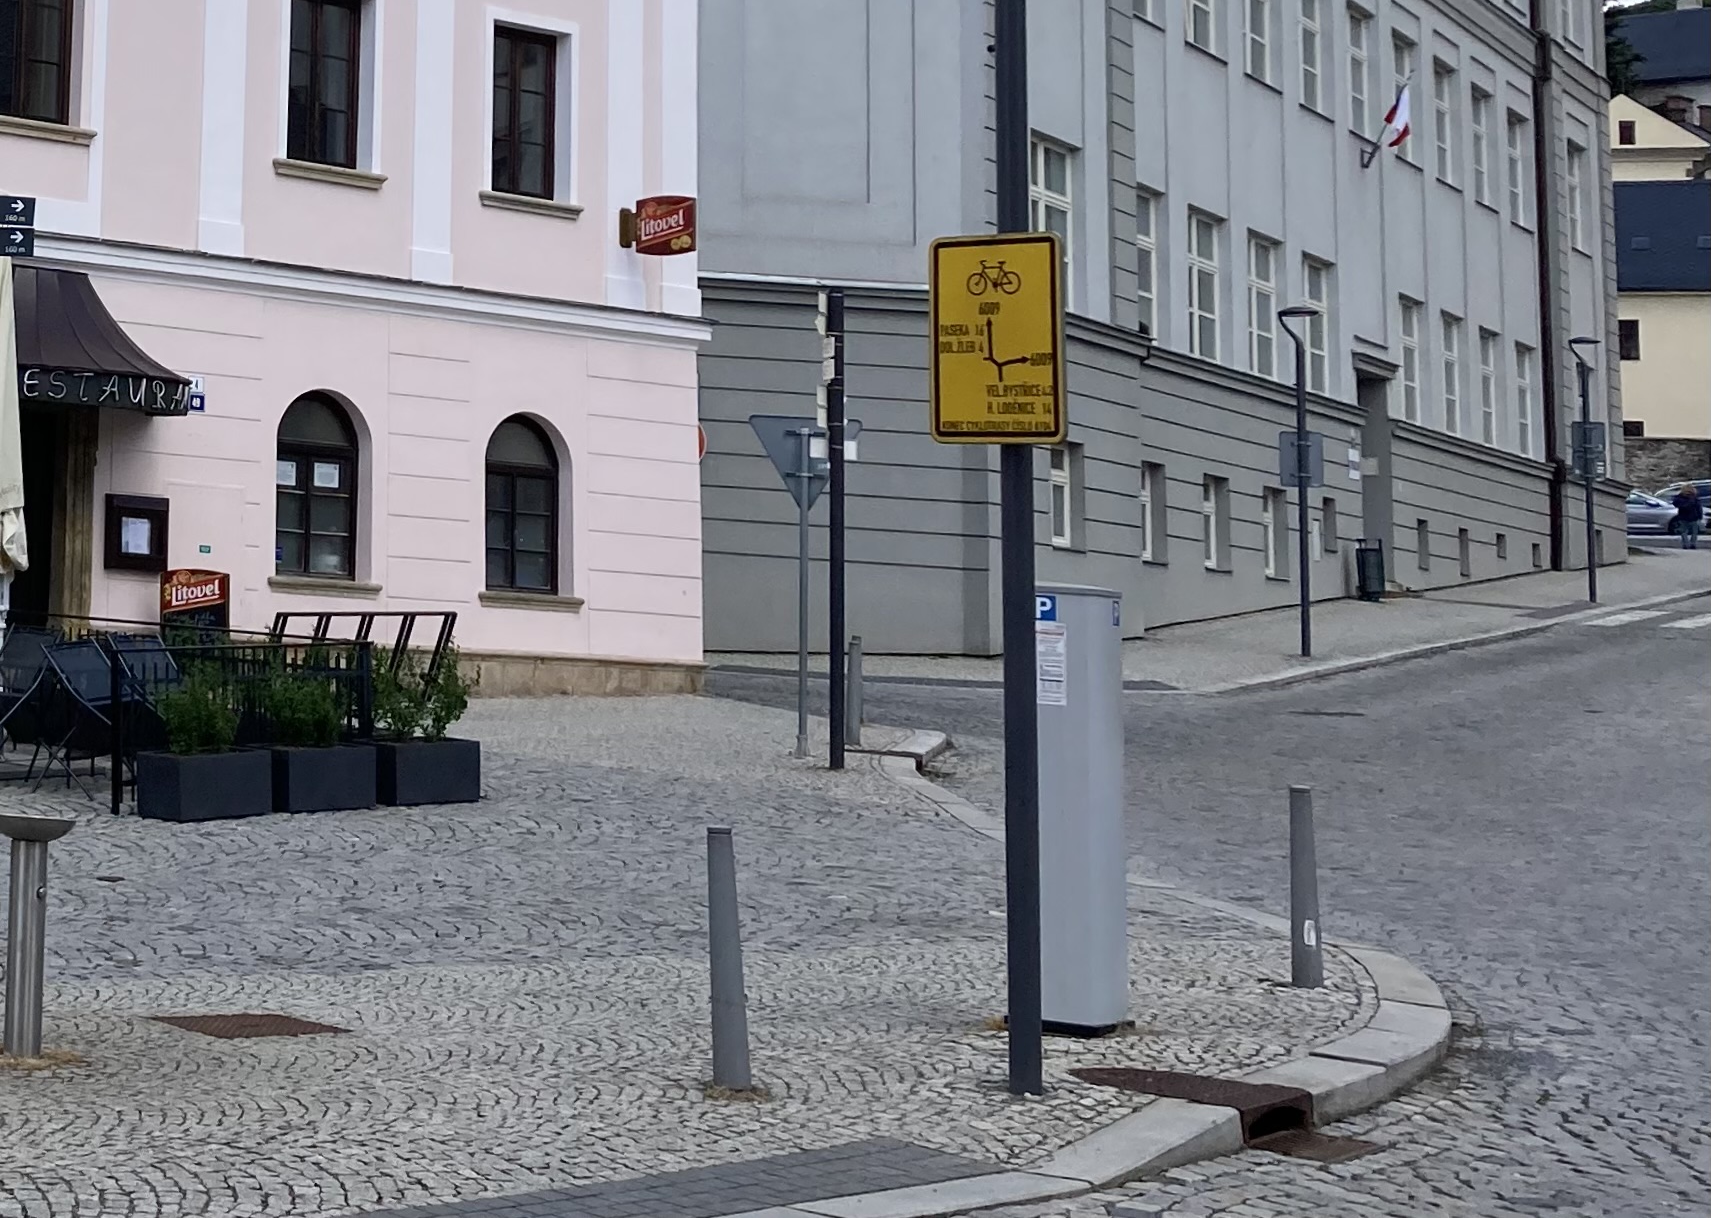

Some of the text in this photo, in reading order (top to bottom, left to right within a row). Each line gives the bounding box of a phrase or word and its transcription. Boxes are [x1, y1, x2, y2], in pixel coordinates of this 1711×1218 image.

[640, 209, 684, 241] Litovel
[23, 368, 188, 410] ESTAURA
[171, 579, 220, 606] Litovel
[1036, 596, 1053, 620] P
